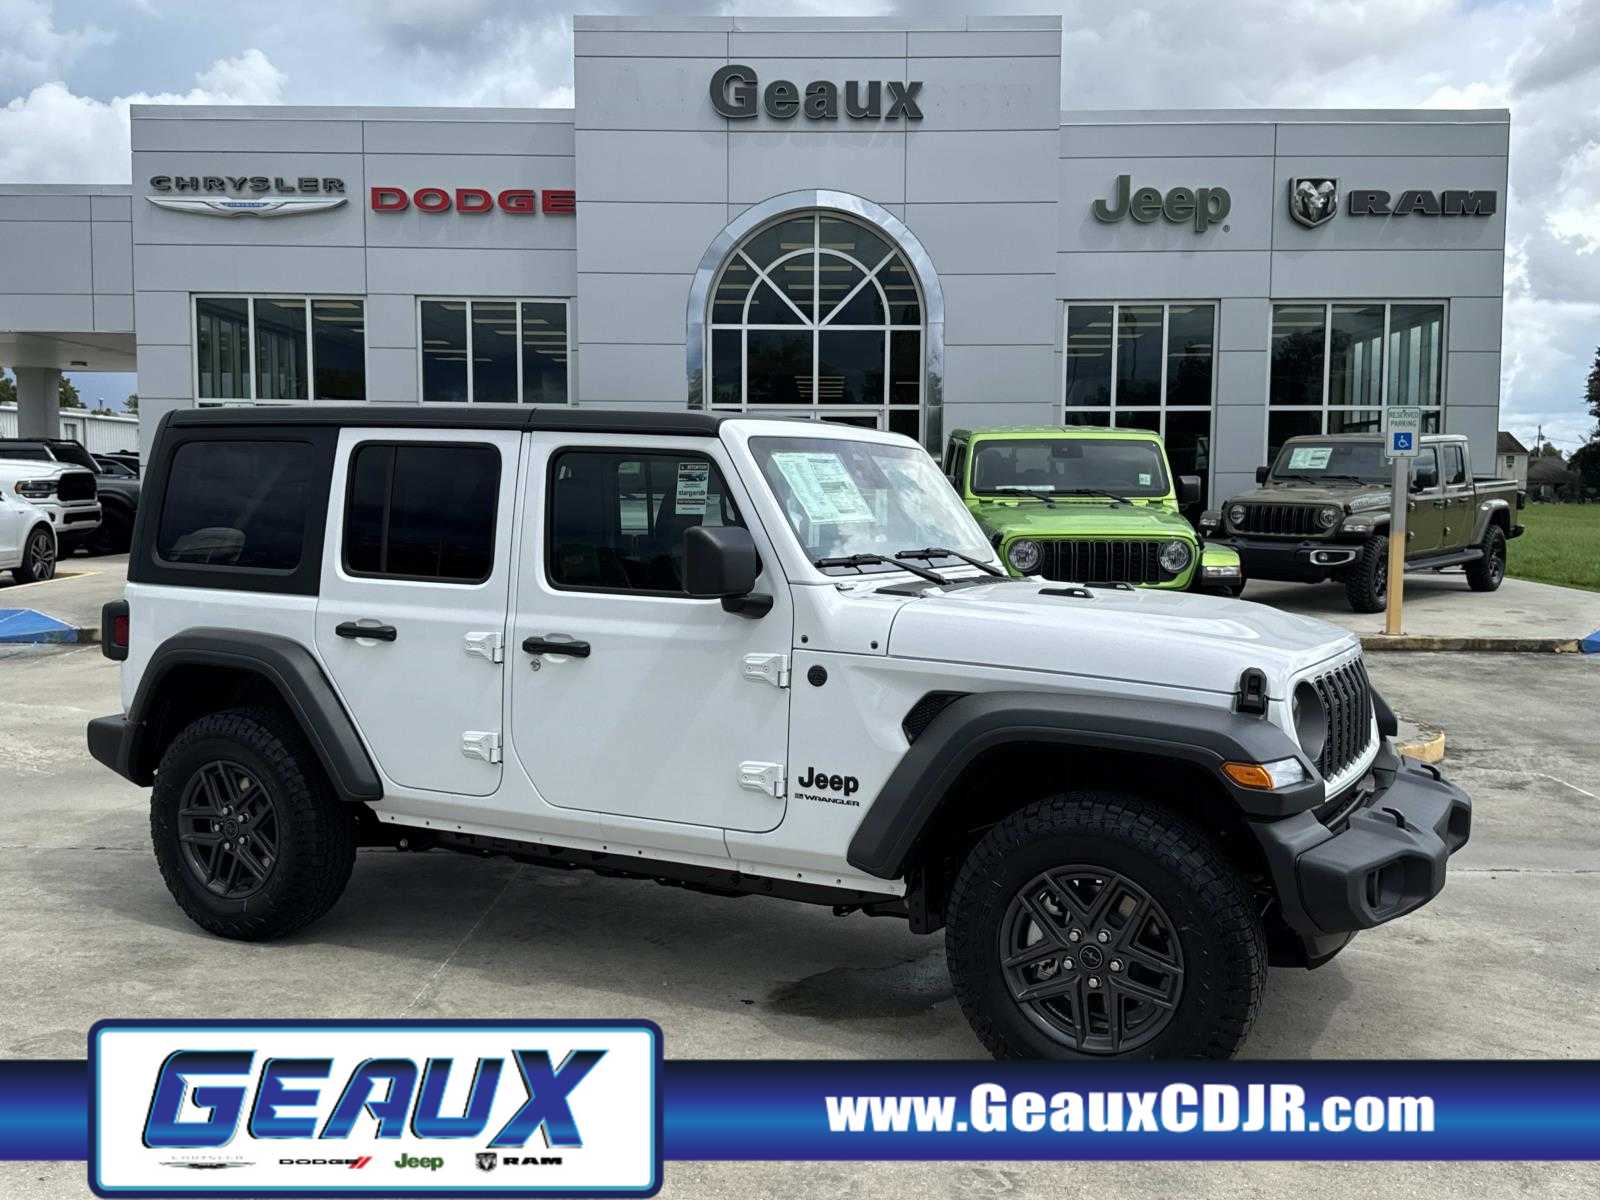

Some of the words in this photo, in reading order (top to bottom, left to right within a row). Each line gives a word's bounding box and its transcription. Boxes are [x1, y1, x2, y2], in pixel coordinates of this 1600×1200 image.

[709, 64, 923, 120] Geaux
[150, 175, 345, 193] CHRYSLER
[371, 187, 576, 214] DODGE
[1093, 175, 1231, 232] Jeep
[1349, 190, 1497, 216] RAM
[798, 767, 859, 796] Jeep
[804, 794, 860, 807] WRANGLER
